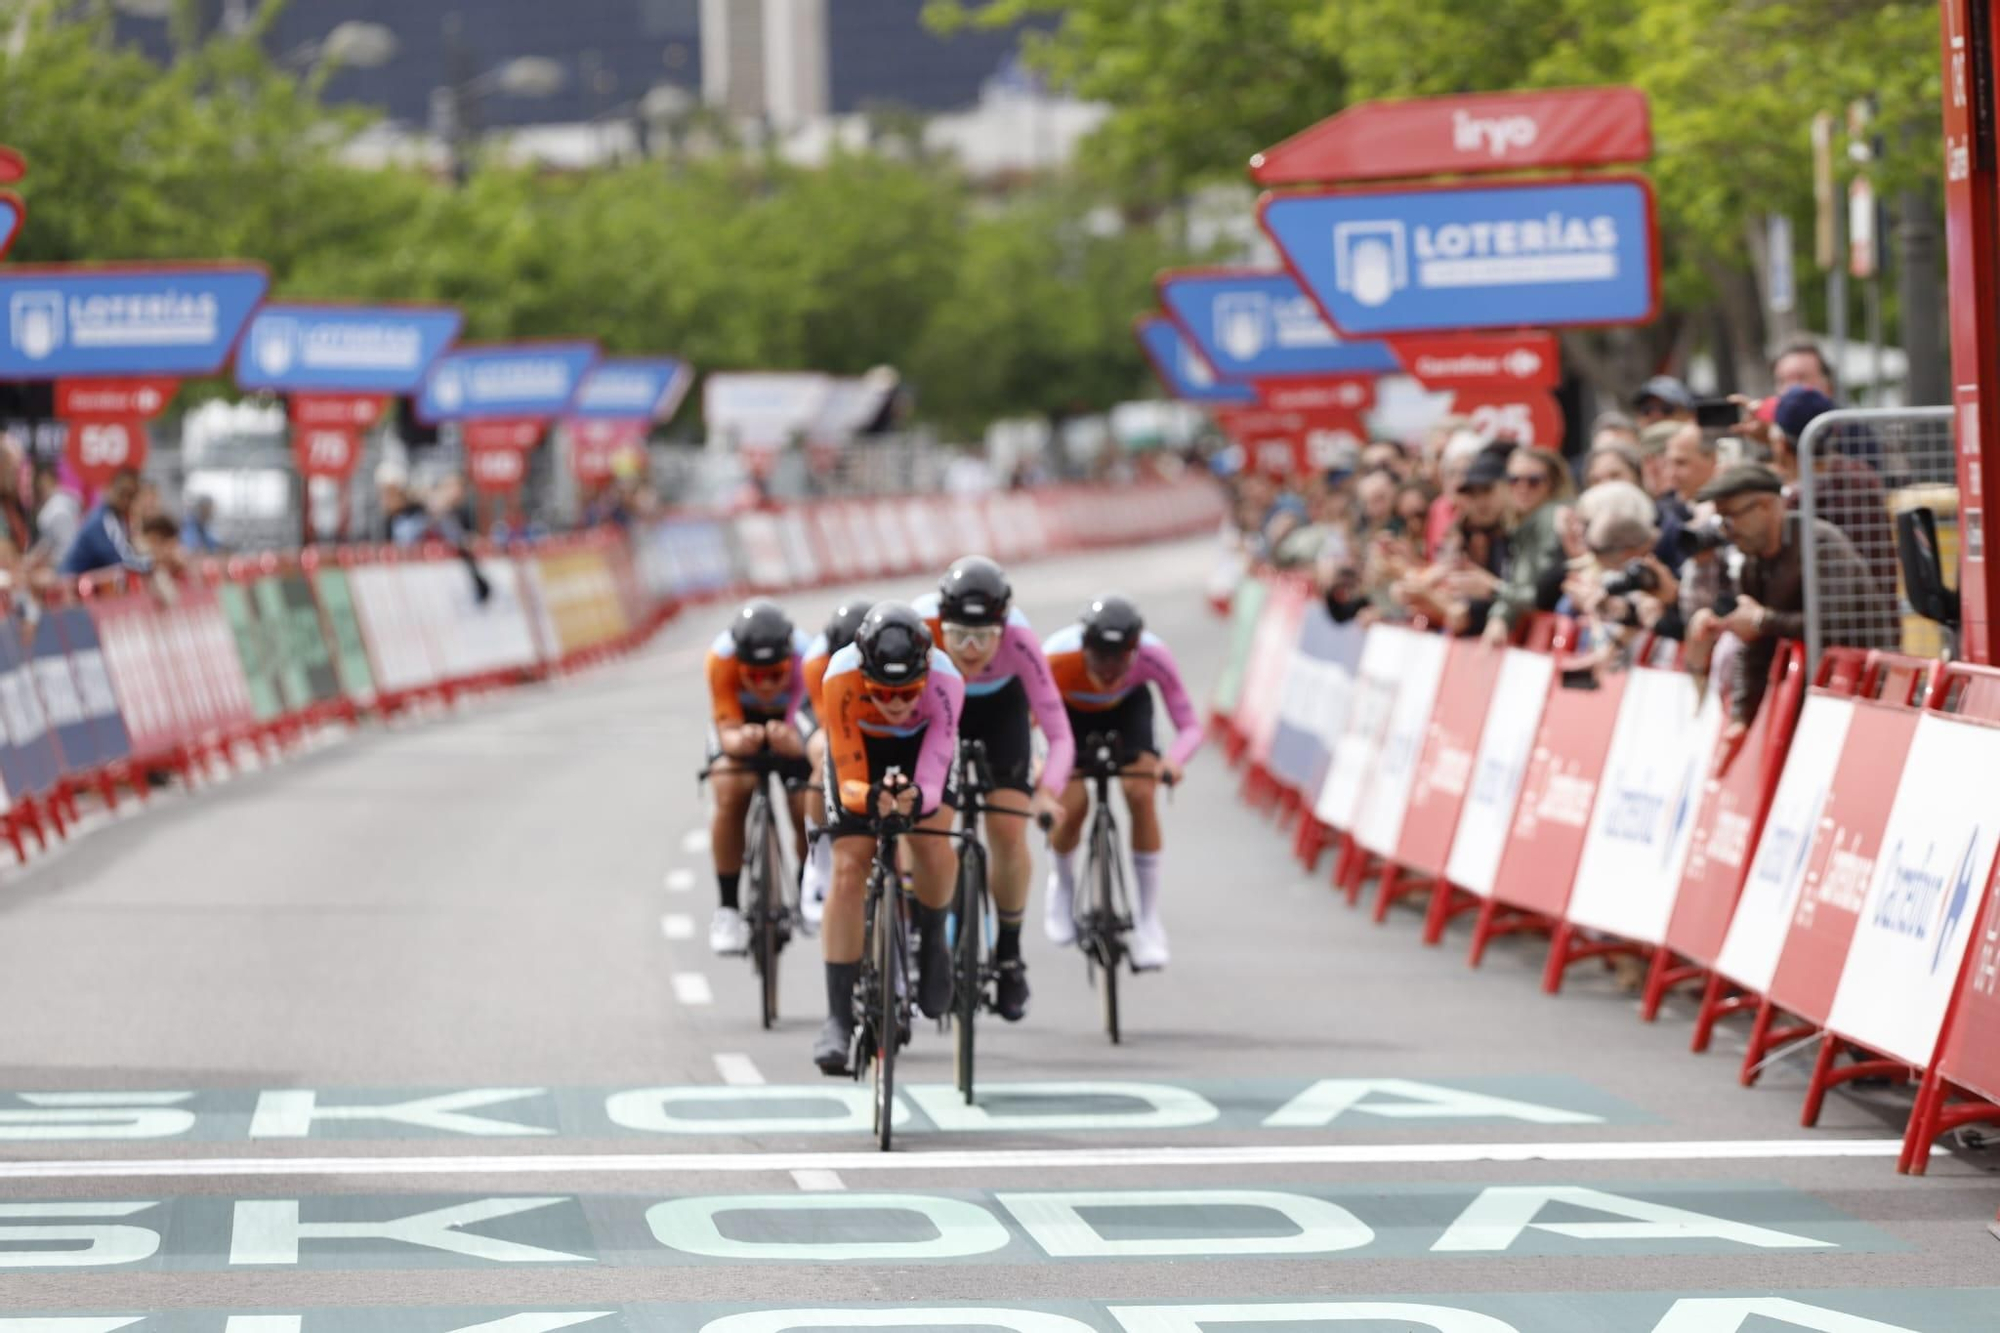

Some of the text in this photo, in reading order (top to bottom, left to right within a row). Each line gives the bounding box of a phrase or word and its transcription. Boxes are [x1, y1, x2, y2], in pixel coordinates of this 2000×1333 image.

[1453, 109, 1537, 158] iryo
[1414, 211, 1619, 259] LOTERÍAS
[79, 422, 130, 467] 50
